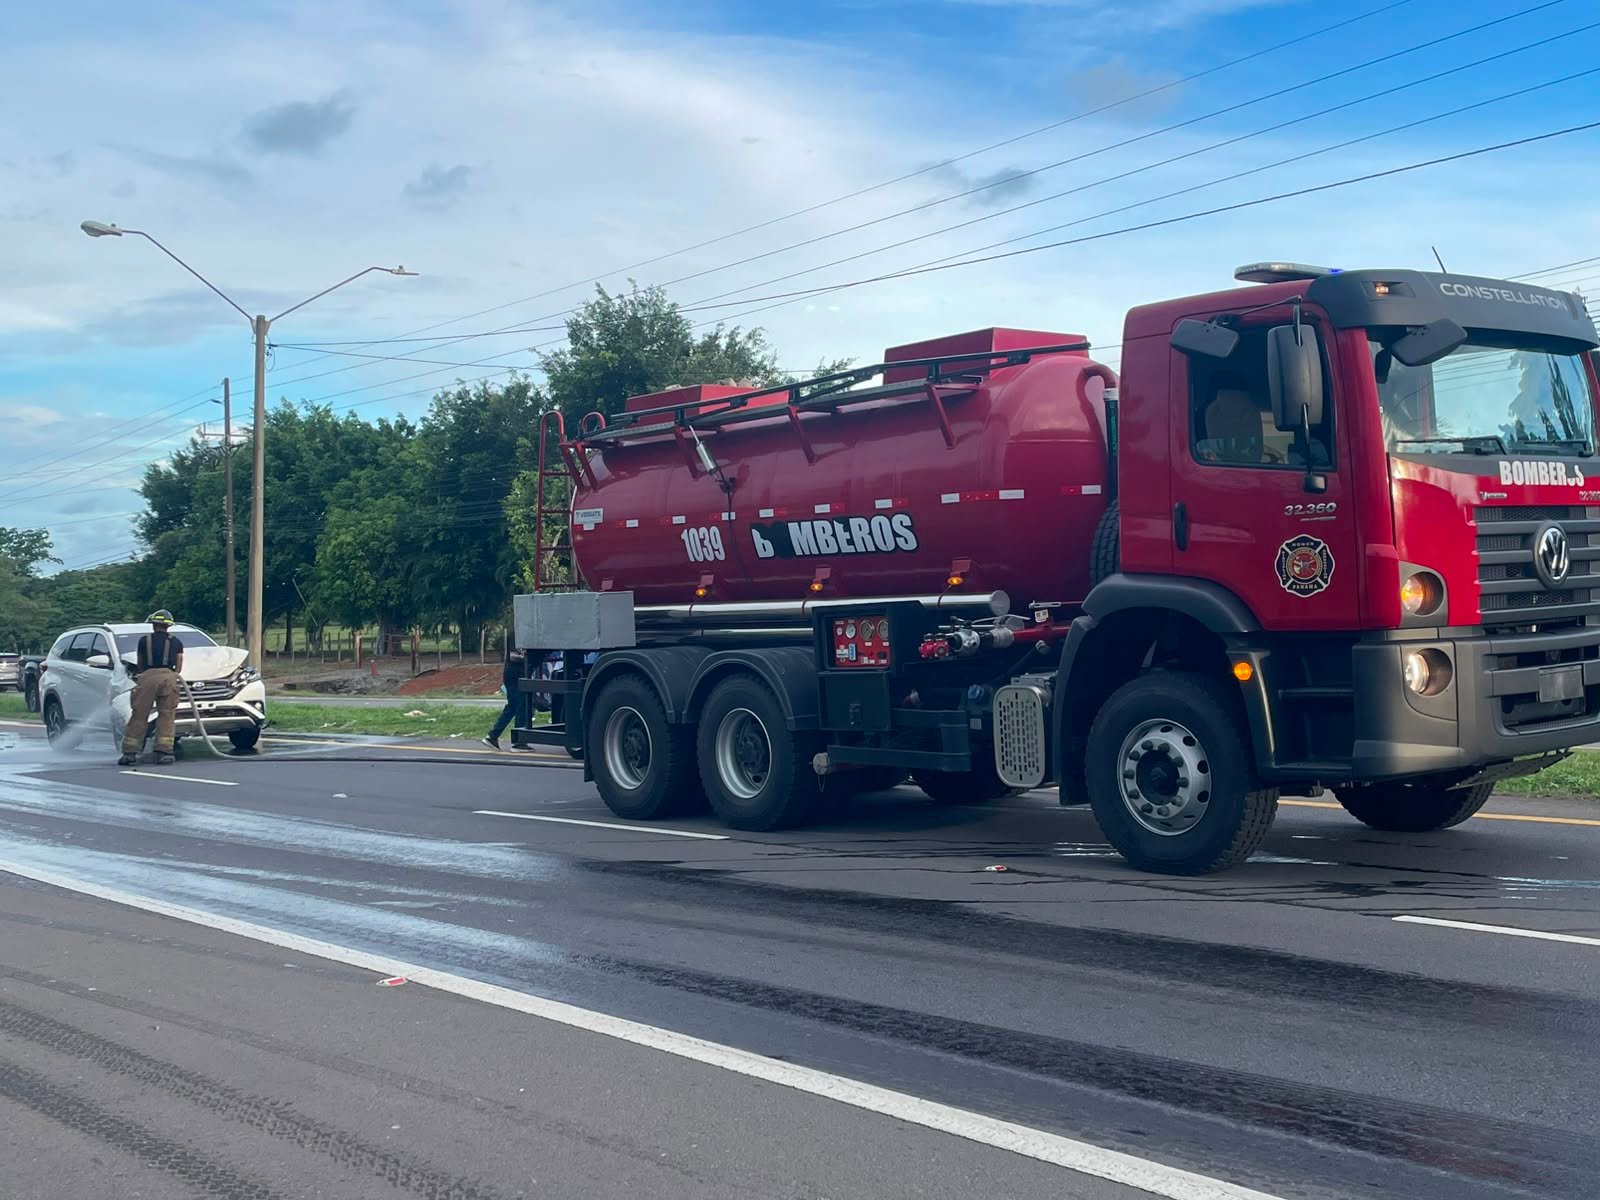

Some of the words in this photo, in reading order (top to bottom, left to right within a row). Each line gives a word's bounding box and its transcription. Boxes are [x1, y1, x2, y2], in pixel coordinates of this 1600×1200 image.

[1439, 282, 1568, 311] CONSTELLATION
[681, 526, 726, 562] 1039
[751, 513, 918, 558] BMBEROS
